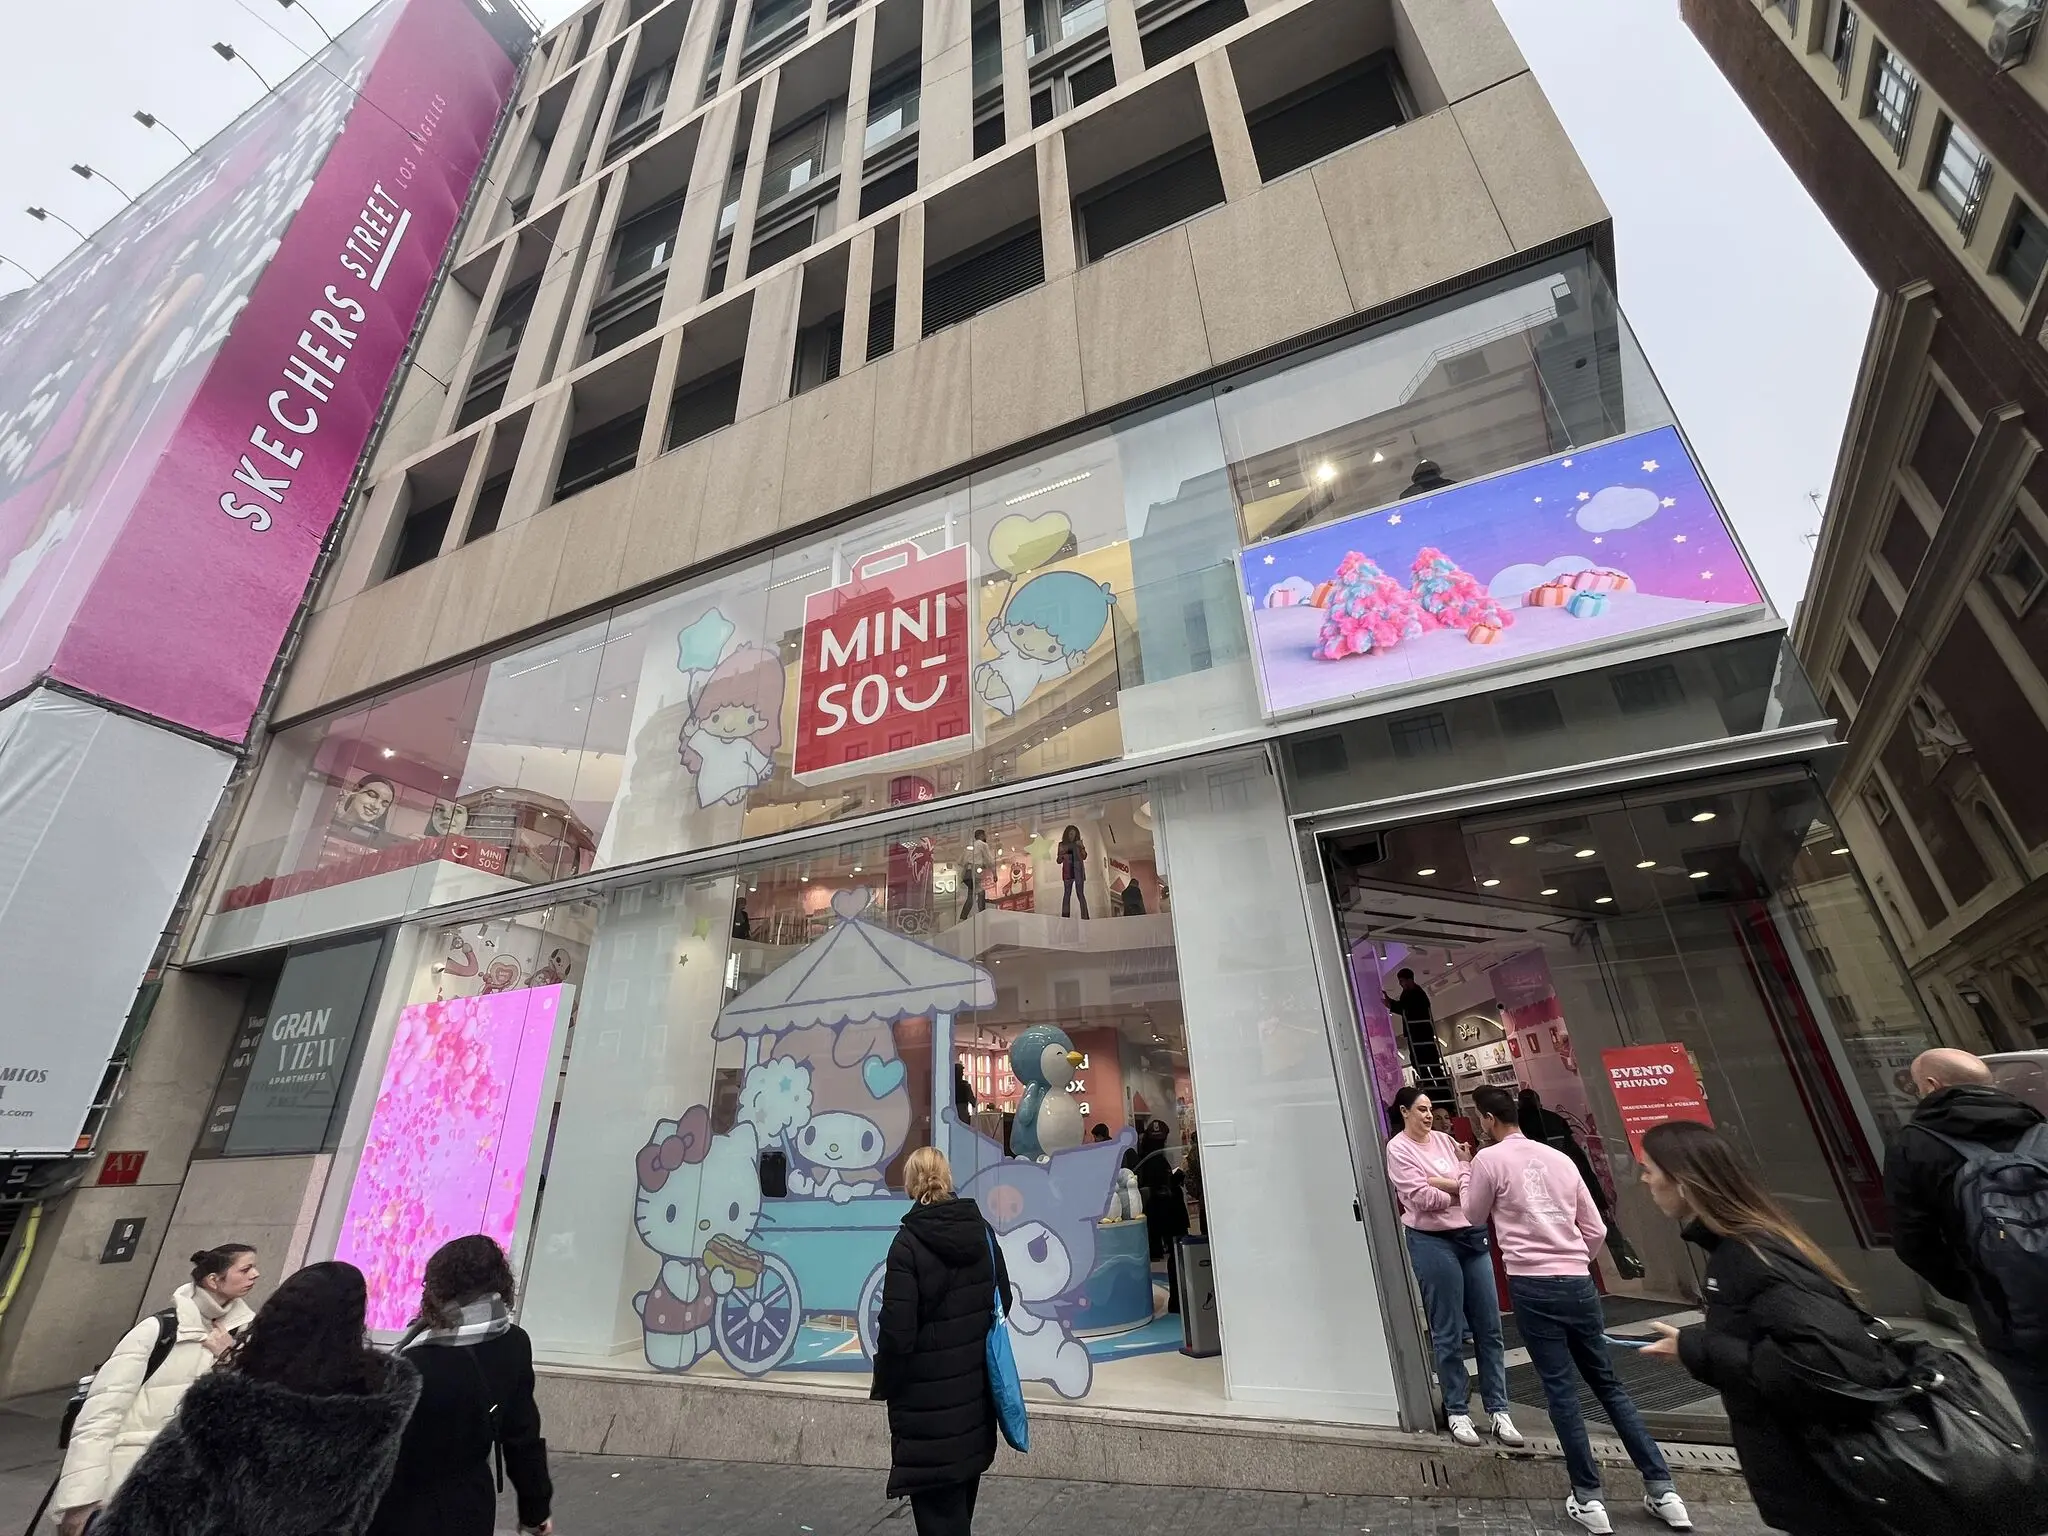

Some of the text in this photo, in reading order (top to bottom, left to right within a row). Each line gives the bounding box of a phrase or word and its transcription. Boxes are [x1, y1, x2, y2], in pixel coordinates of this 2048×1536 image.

[219, 284, 366, 532] SKECHERS
[339, 181, 400, 280] STREET
[395, 157, 417, 190] LOS
[820, 592, 947, 673] MINI
[480, 848, 502, 861] MINI
[272, 1008, 332, 1041] GRAN
[269, 1072, 327, 1085] APARTMENTS
[1609, 1064, 1675, 1079] EVENTO
[1614, 1077, 1668, 1089] PRIVADO
[106, 1153, 142, 1172] AT
